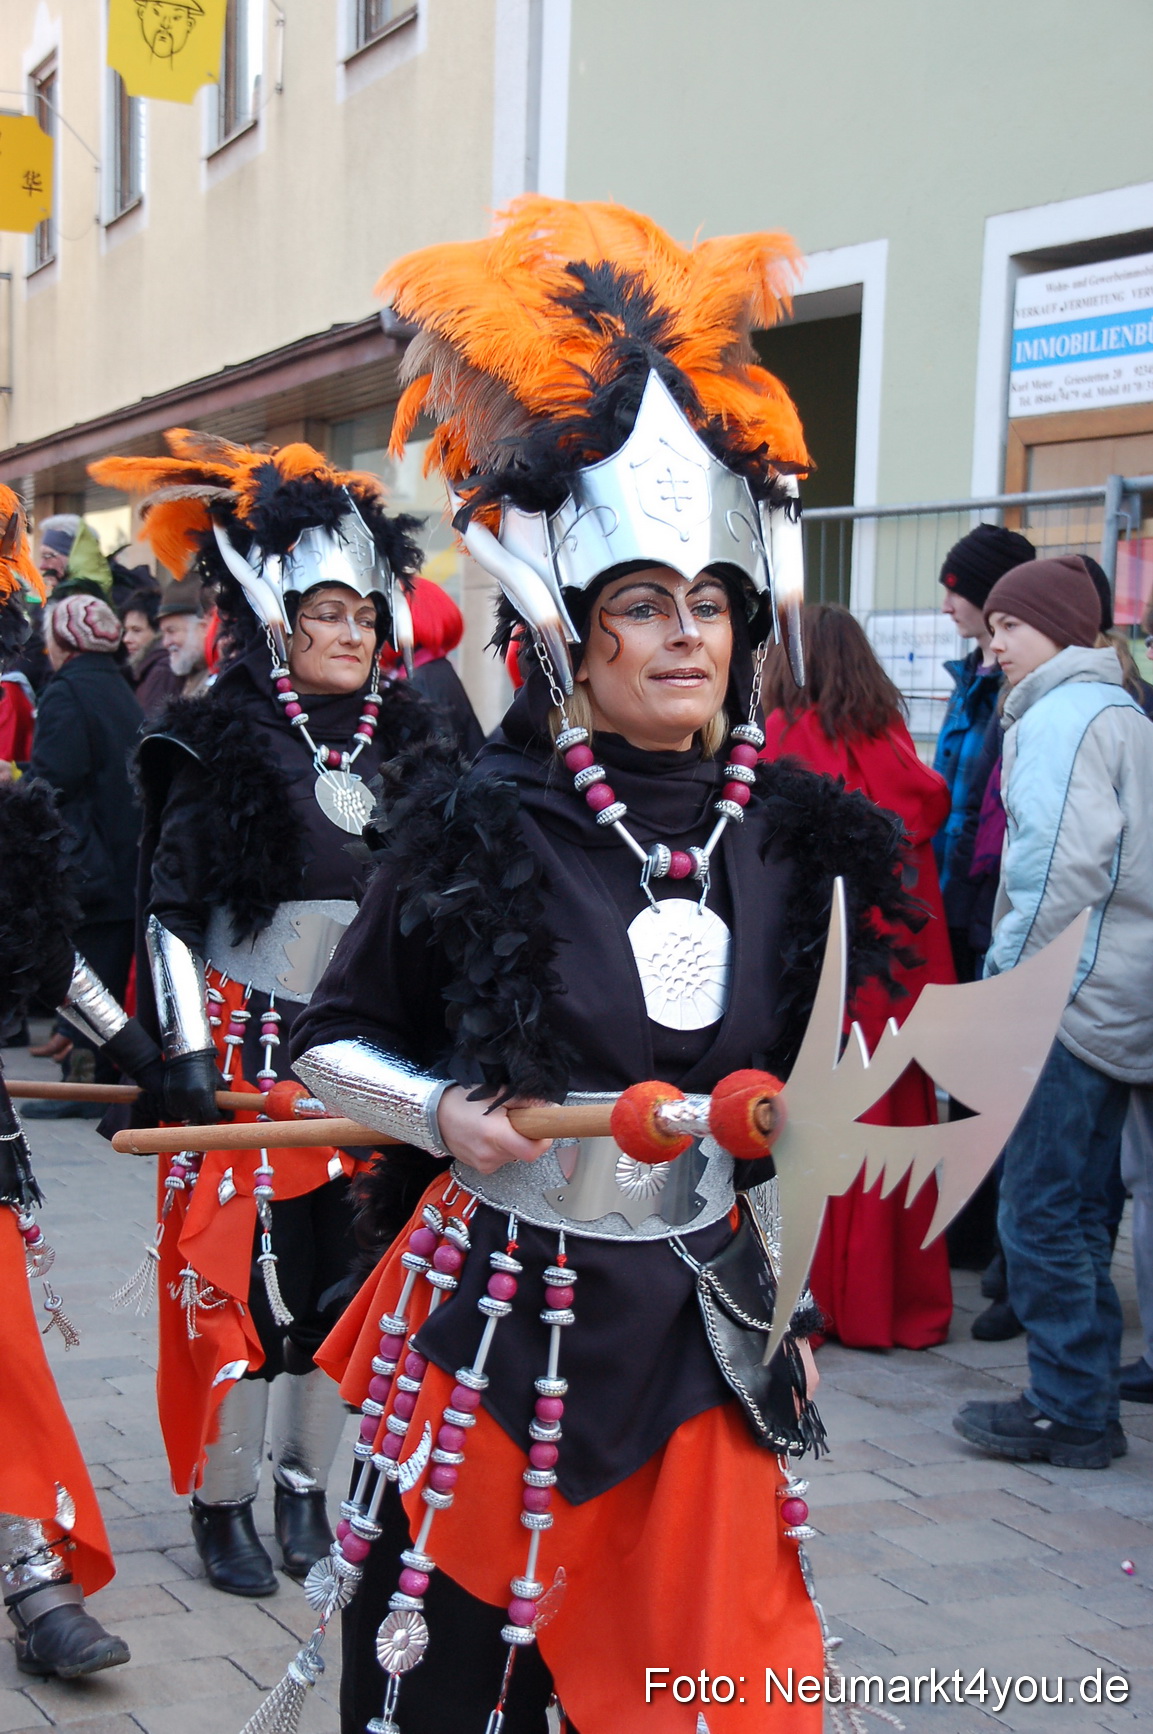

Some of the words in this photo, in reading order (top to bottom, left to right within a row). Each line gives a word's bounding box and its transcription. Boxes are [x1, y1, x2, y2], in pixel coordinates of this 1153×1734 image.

[21, 170, 44, 198] 华
[1014, 304, 1058, 319] VERKAUF
[1064, 291, 1125, 312] VERMIETUNG
